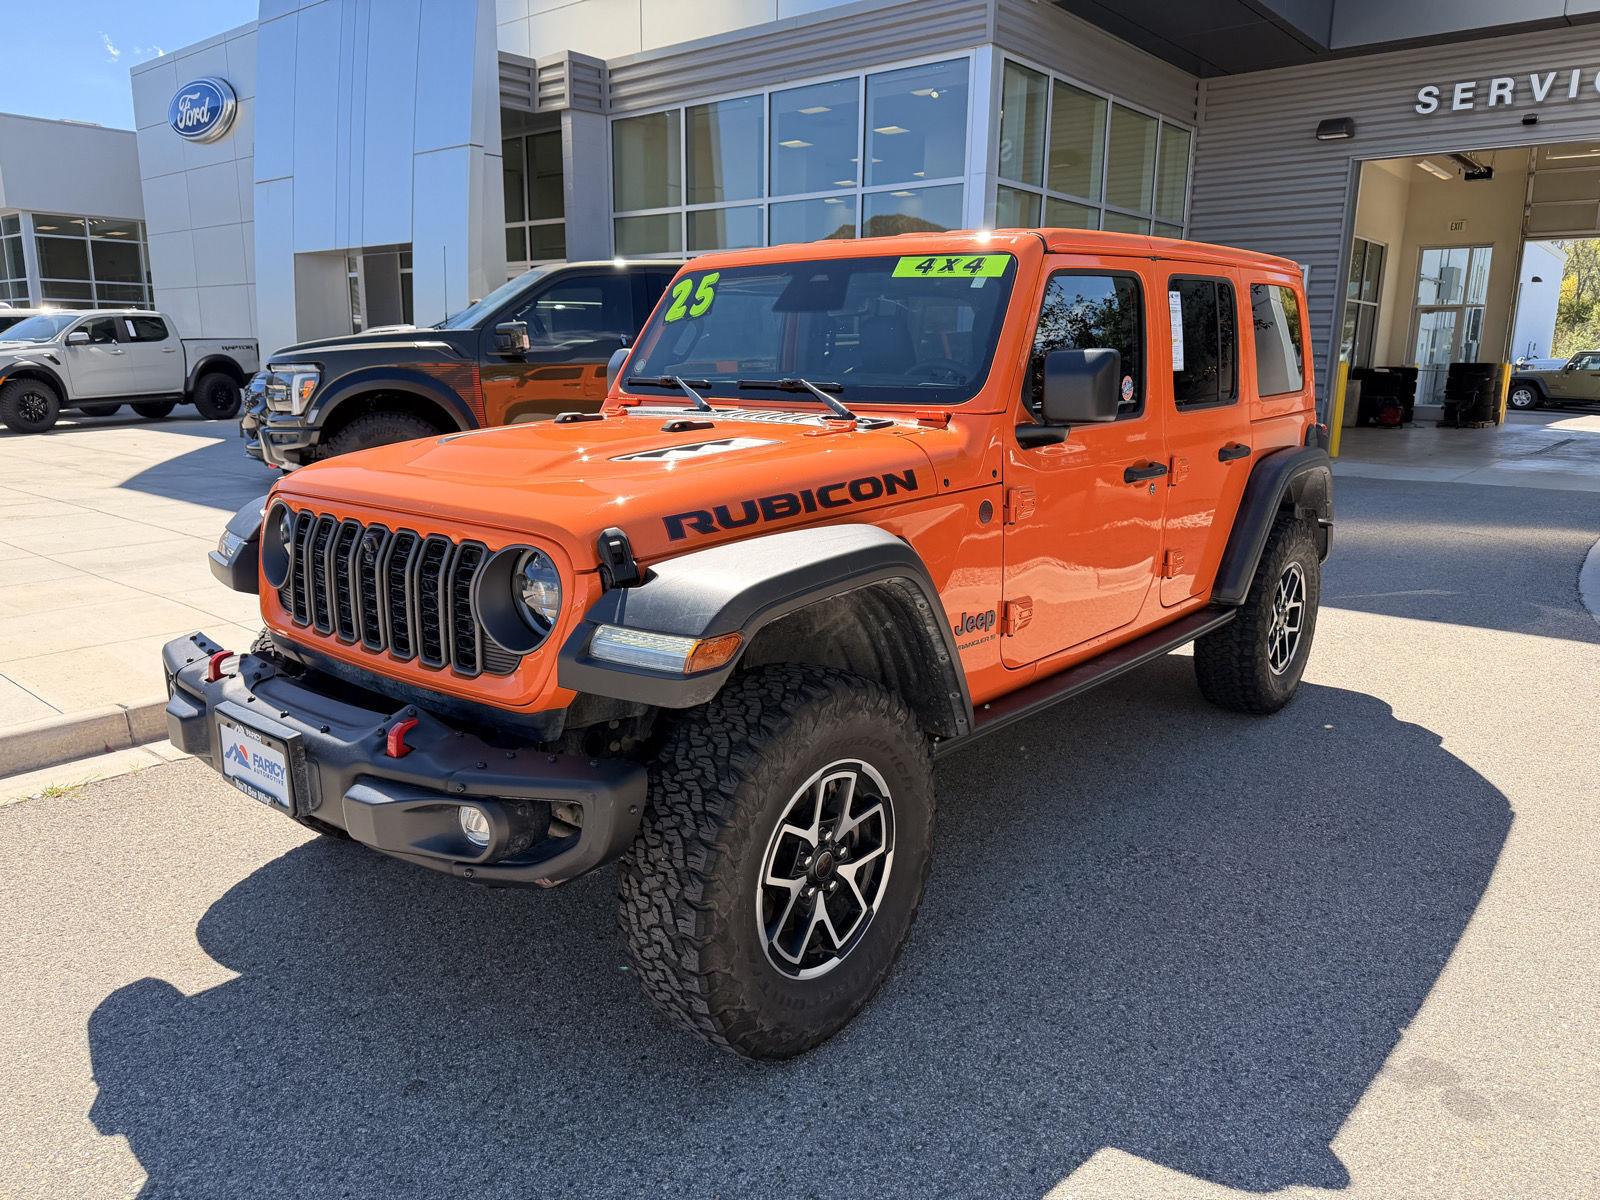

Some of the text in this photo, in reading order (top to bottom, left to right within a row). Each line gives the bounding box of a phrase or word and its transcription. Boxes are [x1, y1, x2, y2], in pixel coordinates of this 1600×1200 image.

[1415, 68, 1600, 115] SERVI
[177, 92, 210, 129] Ford
[1450, 221, 1465, 231] EXIT
[664, 271, 720, 323] 25
[661, 469, 918, 541] RUBICON
[954, 609, 996, 636] Jeep
[252, 753, 285, 779] FARICY
[253, 768, 284, 786] AUTOMOTIVE
